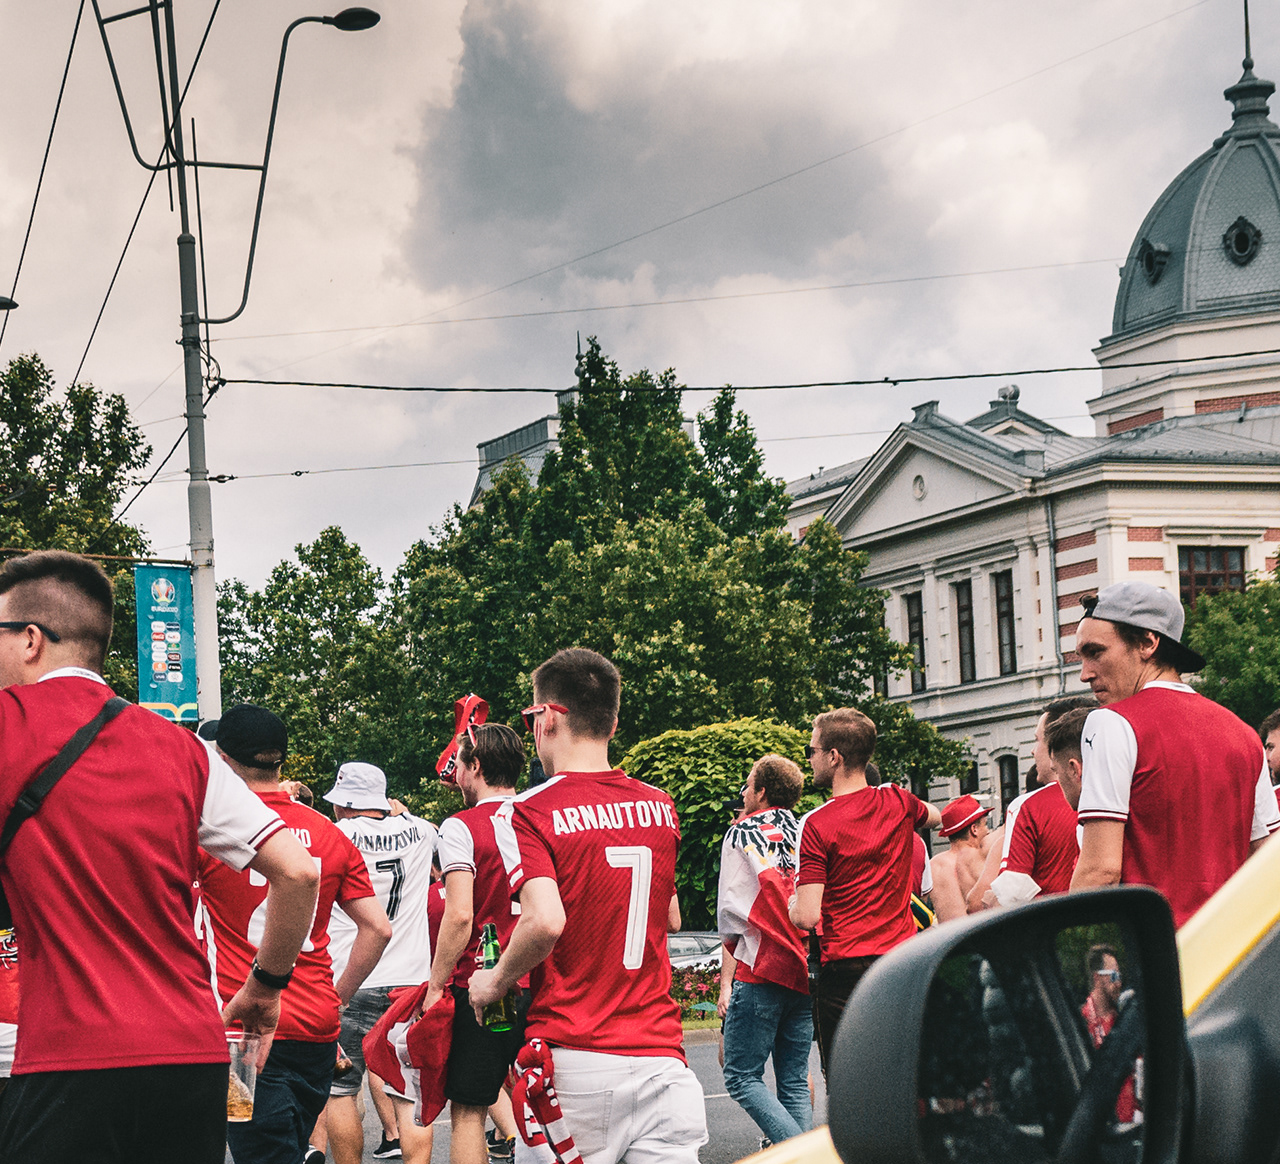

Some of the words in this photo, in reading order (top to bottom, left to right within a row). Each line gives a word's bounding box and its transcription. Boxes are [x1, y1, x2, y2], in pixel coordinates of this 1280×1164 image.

[552, 800, 676, 836] ARNAUTOVIC
[375, 858, 406, 921] 7
[605, 845, 653, 970] 7
